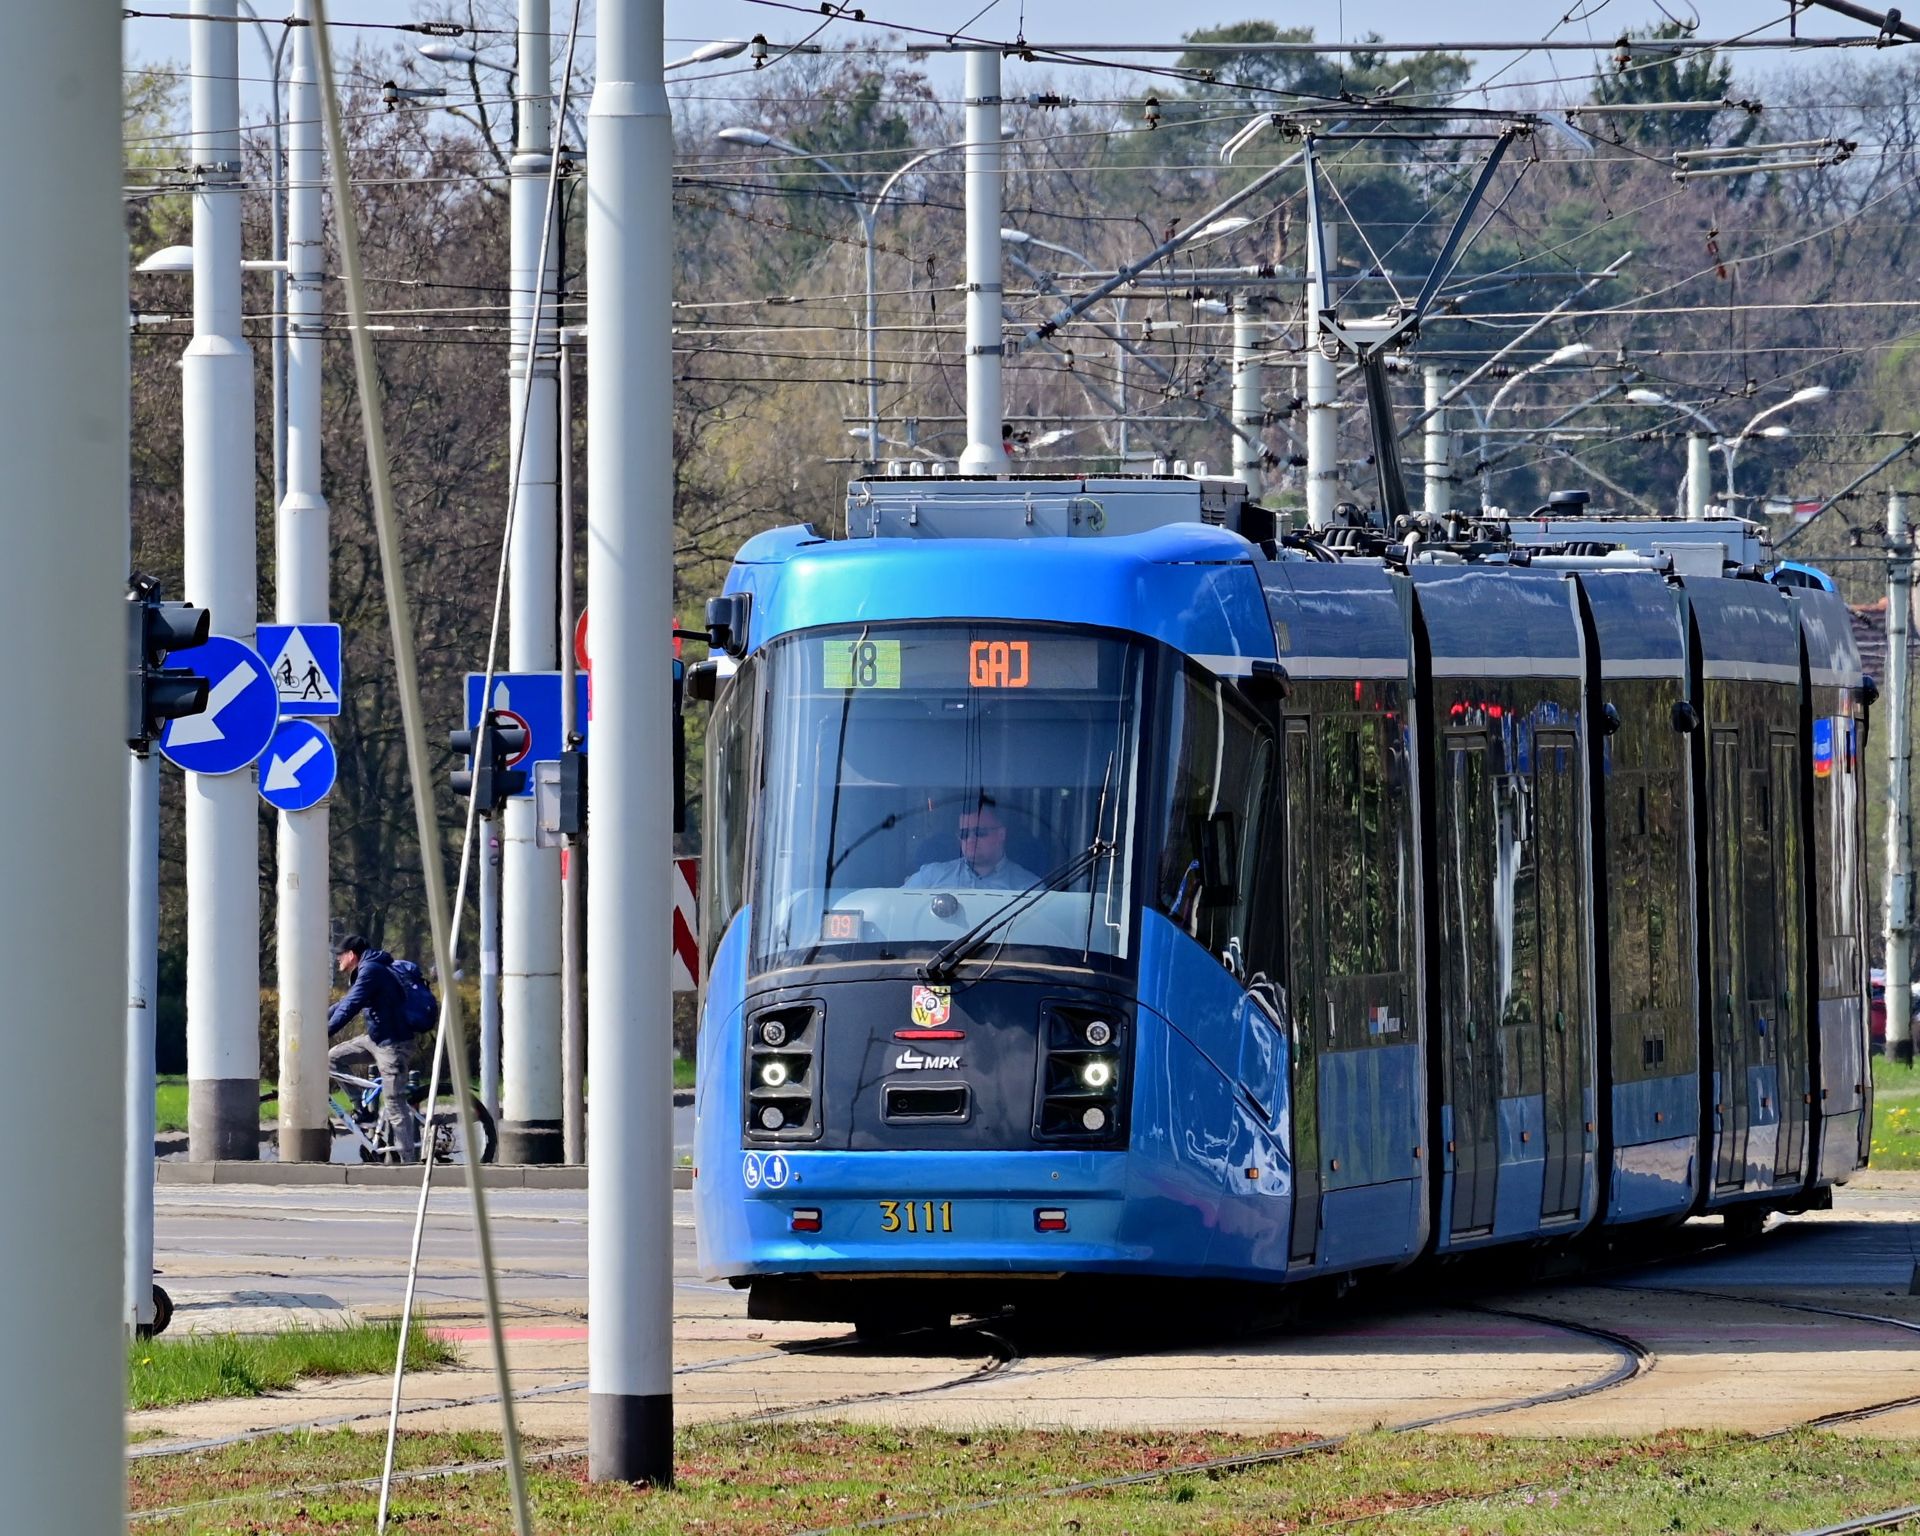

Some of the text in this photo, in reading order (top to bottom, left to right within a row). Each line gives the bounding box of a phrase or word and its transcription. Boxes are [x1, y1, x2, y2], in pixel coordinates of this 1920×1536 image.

[849, 641, 877, 687] 18
[969, 641, 1030, 688] GAJ
[832, 915, 851, 937] 09
[924, 1056, 961, 1069] MPK
[879, 1201, 953, 1233] 3111
